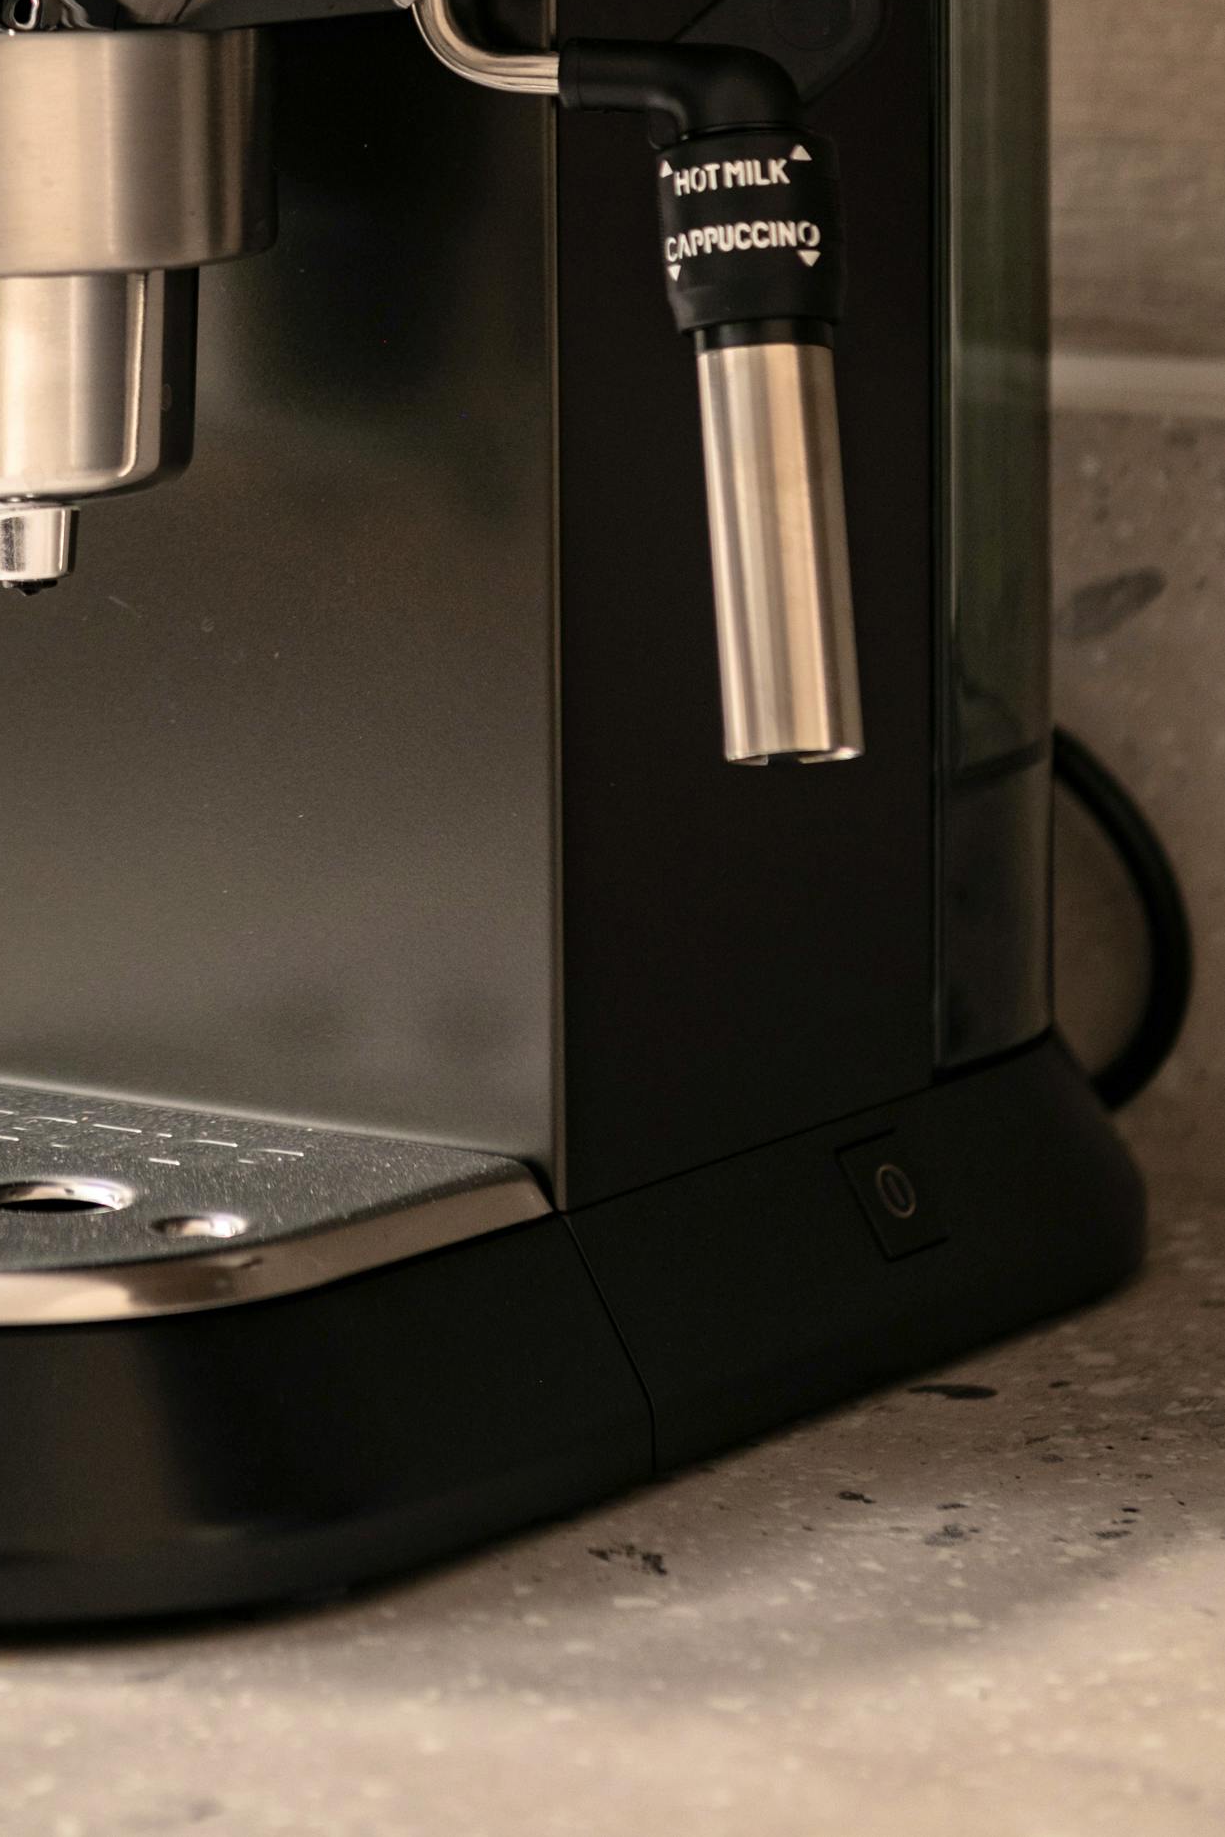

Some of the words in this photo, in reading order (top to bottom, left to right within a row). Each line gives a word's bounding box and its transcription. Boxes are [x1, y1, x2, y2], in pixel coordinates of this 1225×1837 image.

[673, 163, 721, 197] HOT
[722, 158, 791, 189] MILK
[664, 219, 822, 263] CAPPUCCINO
